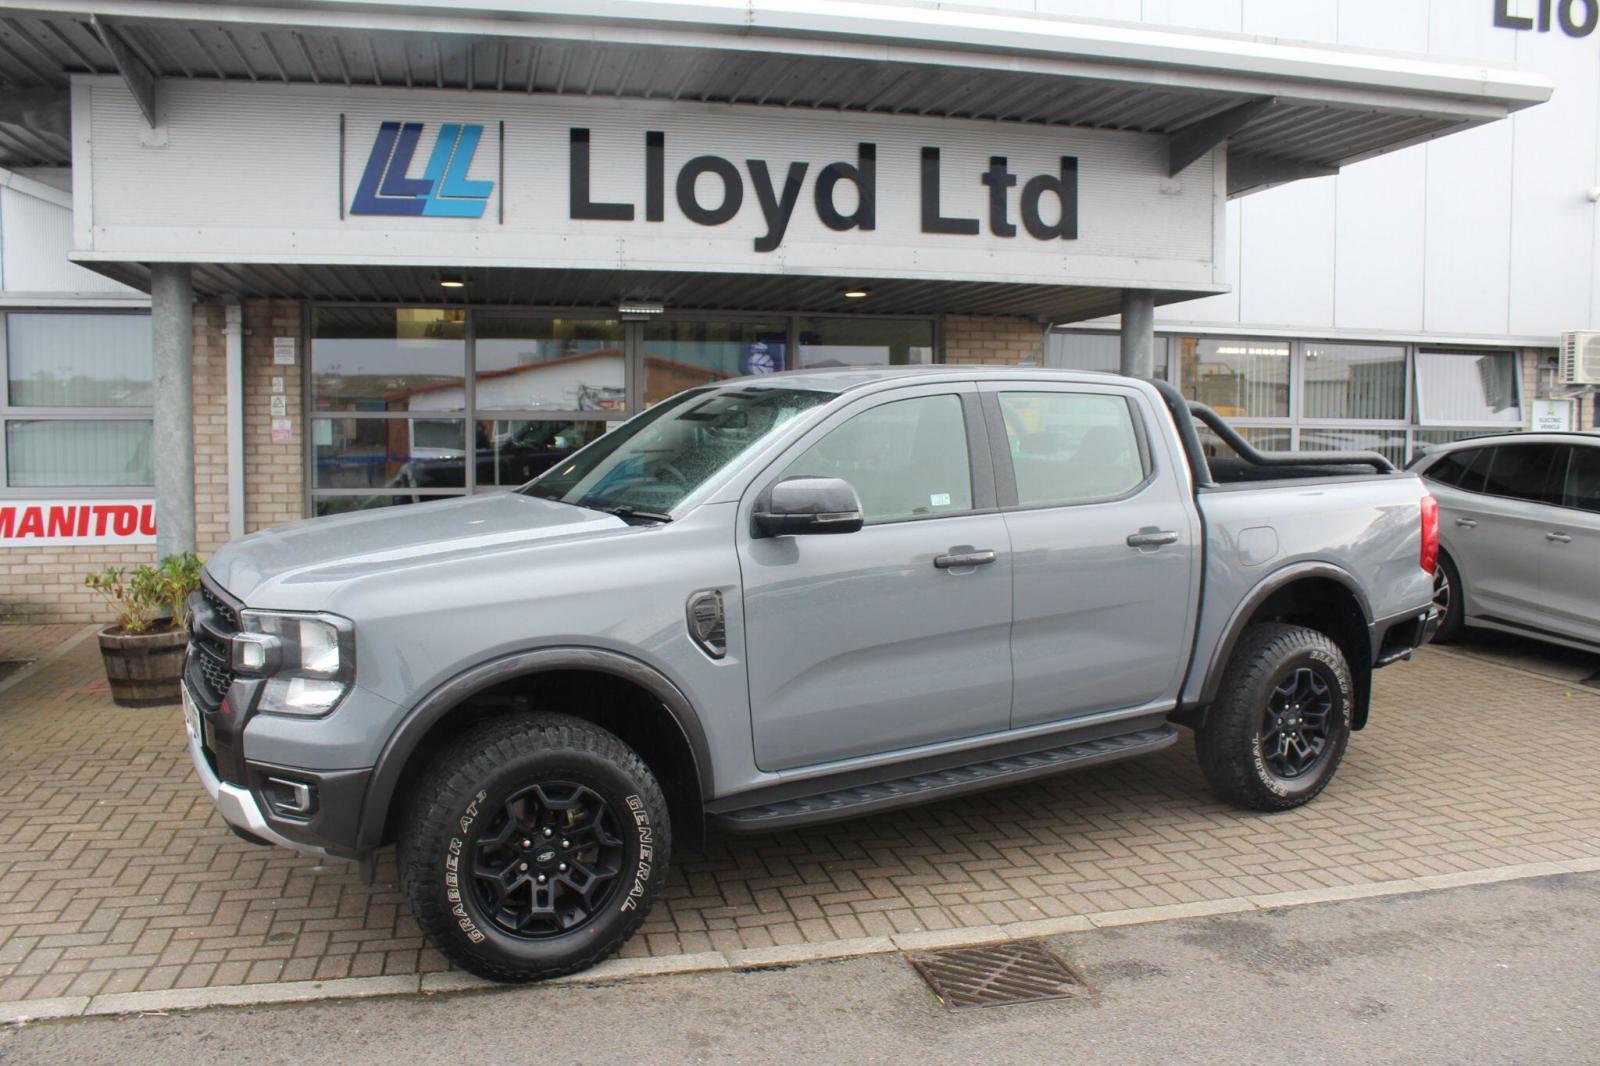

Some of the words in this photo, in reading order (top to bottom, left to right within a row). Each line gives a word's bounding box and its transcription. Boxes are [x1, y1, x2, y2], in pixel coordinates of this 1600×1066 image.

[569, 127, 876, 253] Lloyd
[921, 146, 1078, 240] Ltd
[446, 838, 485, 944] GRABBER
[621, 795, 653, 912] GENERAL
